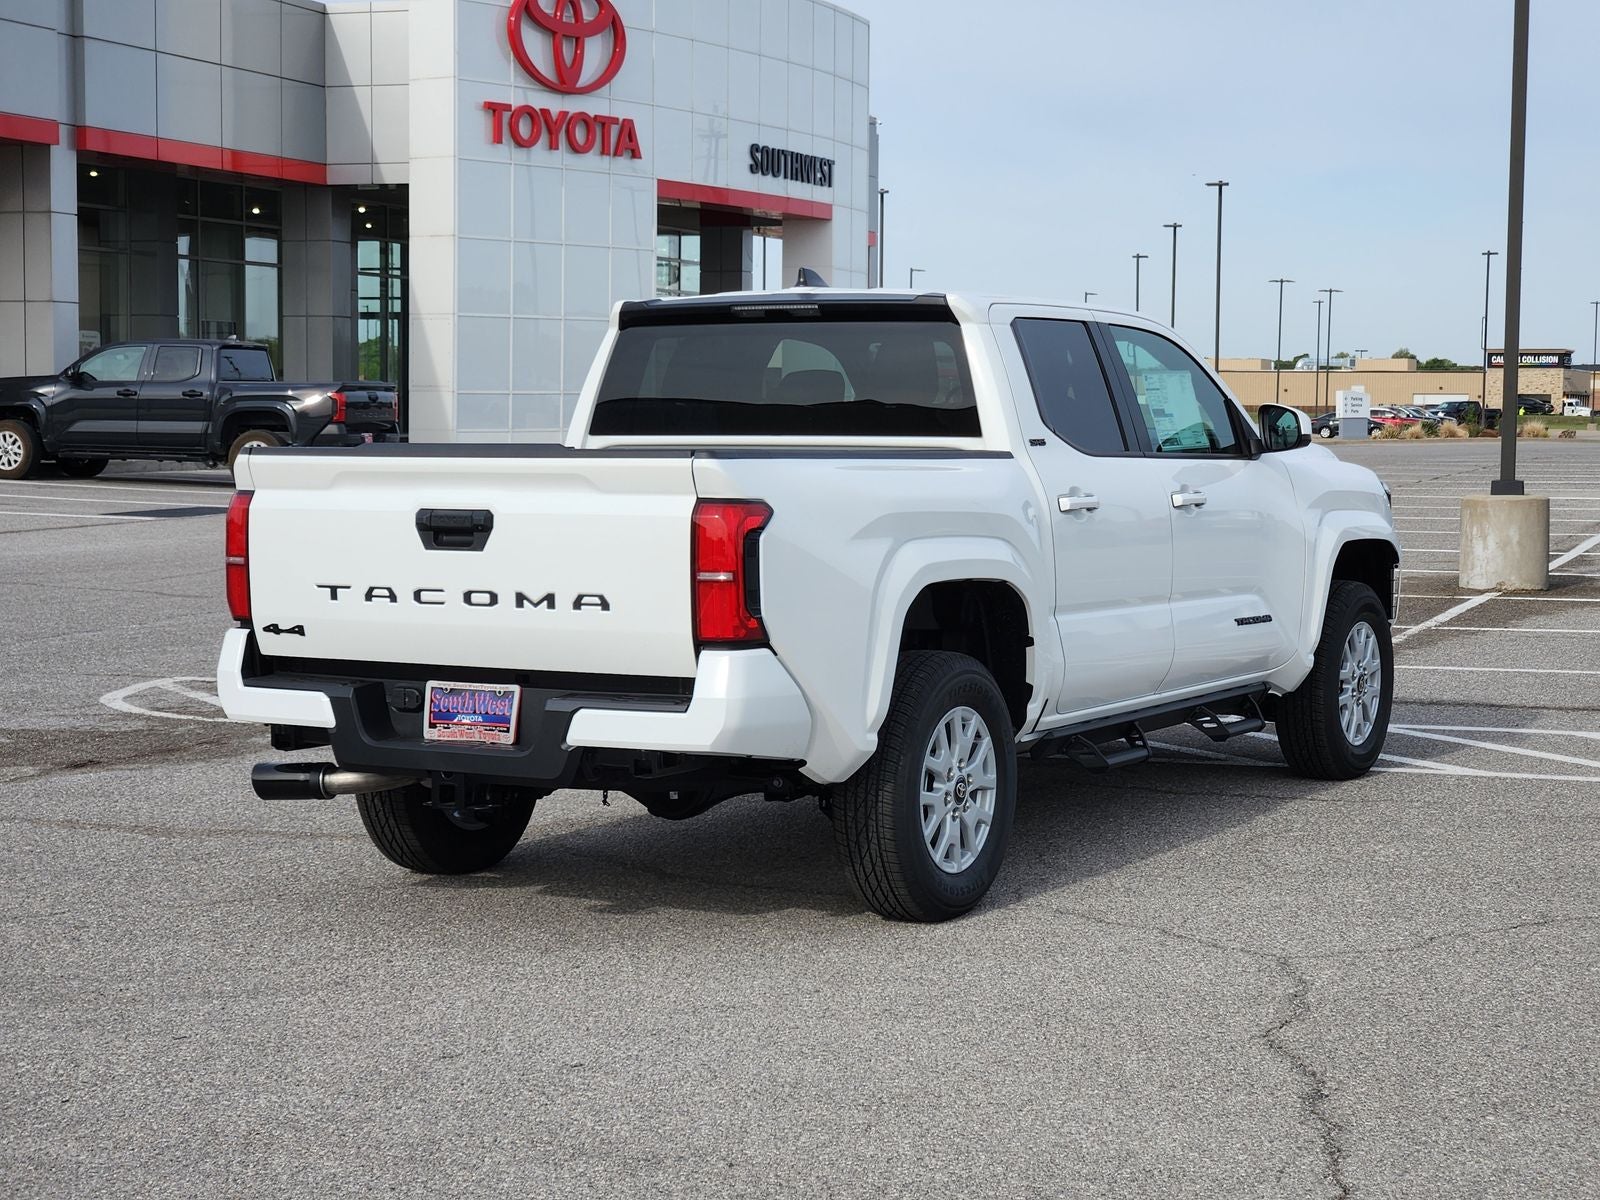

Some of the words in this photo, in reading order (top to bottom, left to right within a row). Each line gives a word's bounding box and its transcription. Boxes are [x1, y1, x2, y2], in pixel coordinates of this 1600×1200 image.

[483, 101, 642, 159] TOYOTA
[750, 143, 835, 188] SOUTHWEST
[1522, 355, 1559, 364] COLLISION
[315, 584, 611, 612] TACOMA
[1234, 614, 1273, 626] TACOMA
[457, 714, 483, 722] TOYOTA
